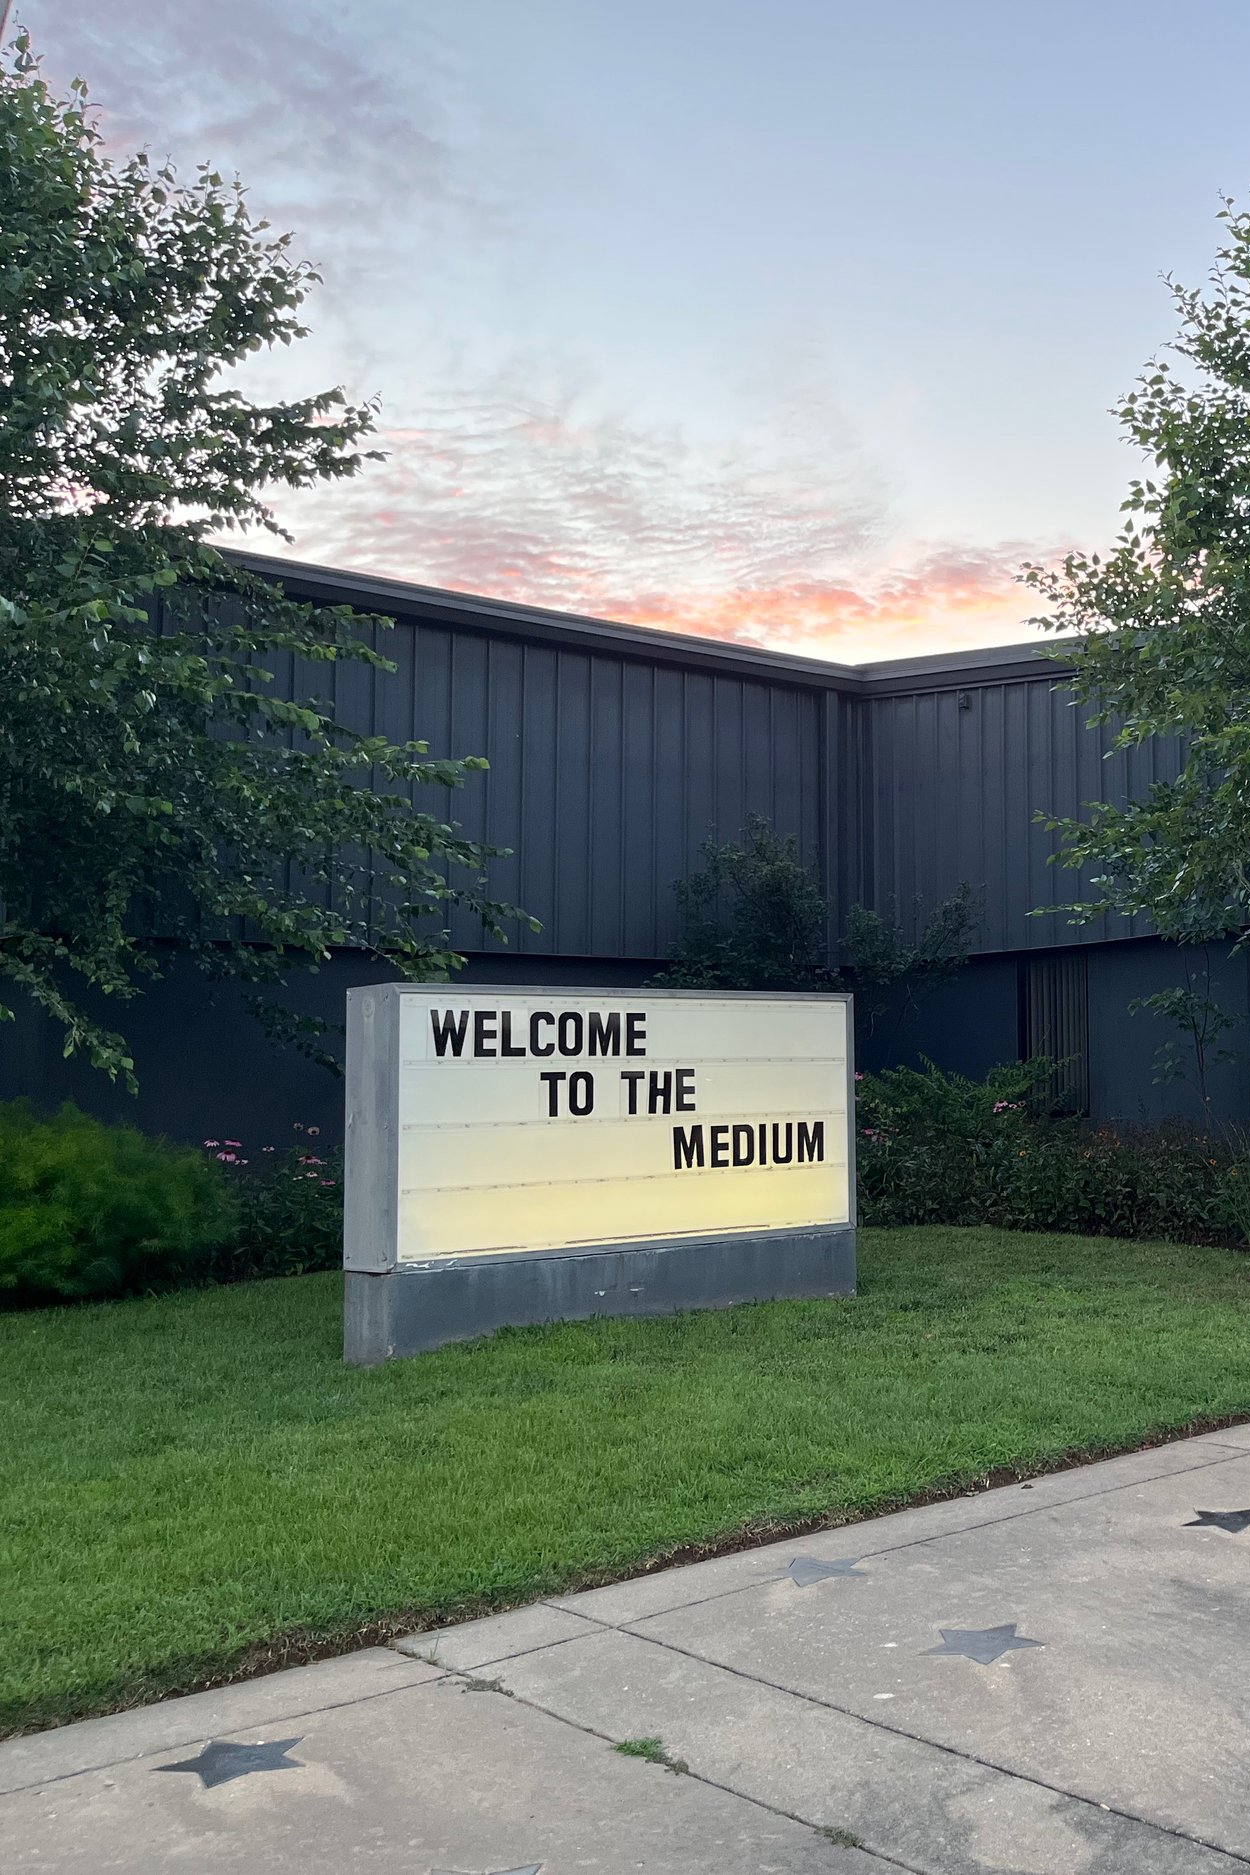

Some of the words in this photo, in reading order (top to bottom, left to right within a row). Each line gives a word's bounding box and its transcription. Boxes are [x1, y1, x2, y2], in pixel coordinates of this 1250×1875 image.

[431, 1010, 647, 1058] WELCOME
[540, 1071, 594, 1118] TO
[620, 1068, 696, 1115] THE
[673, 1121, 825, 1170] MEDIUM
